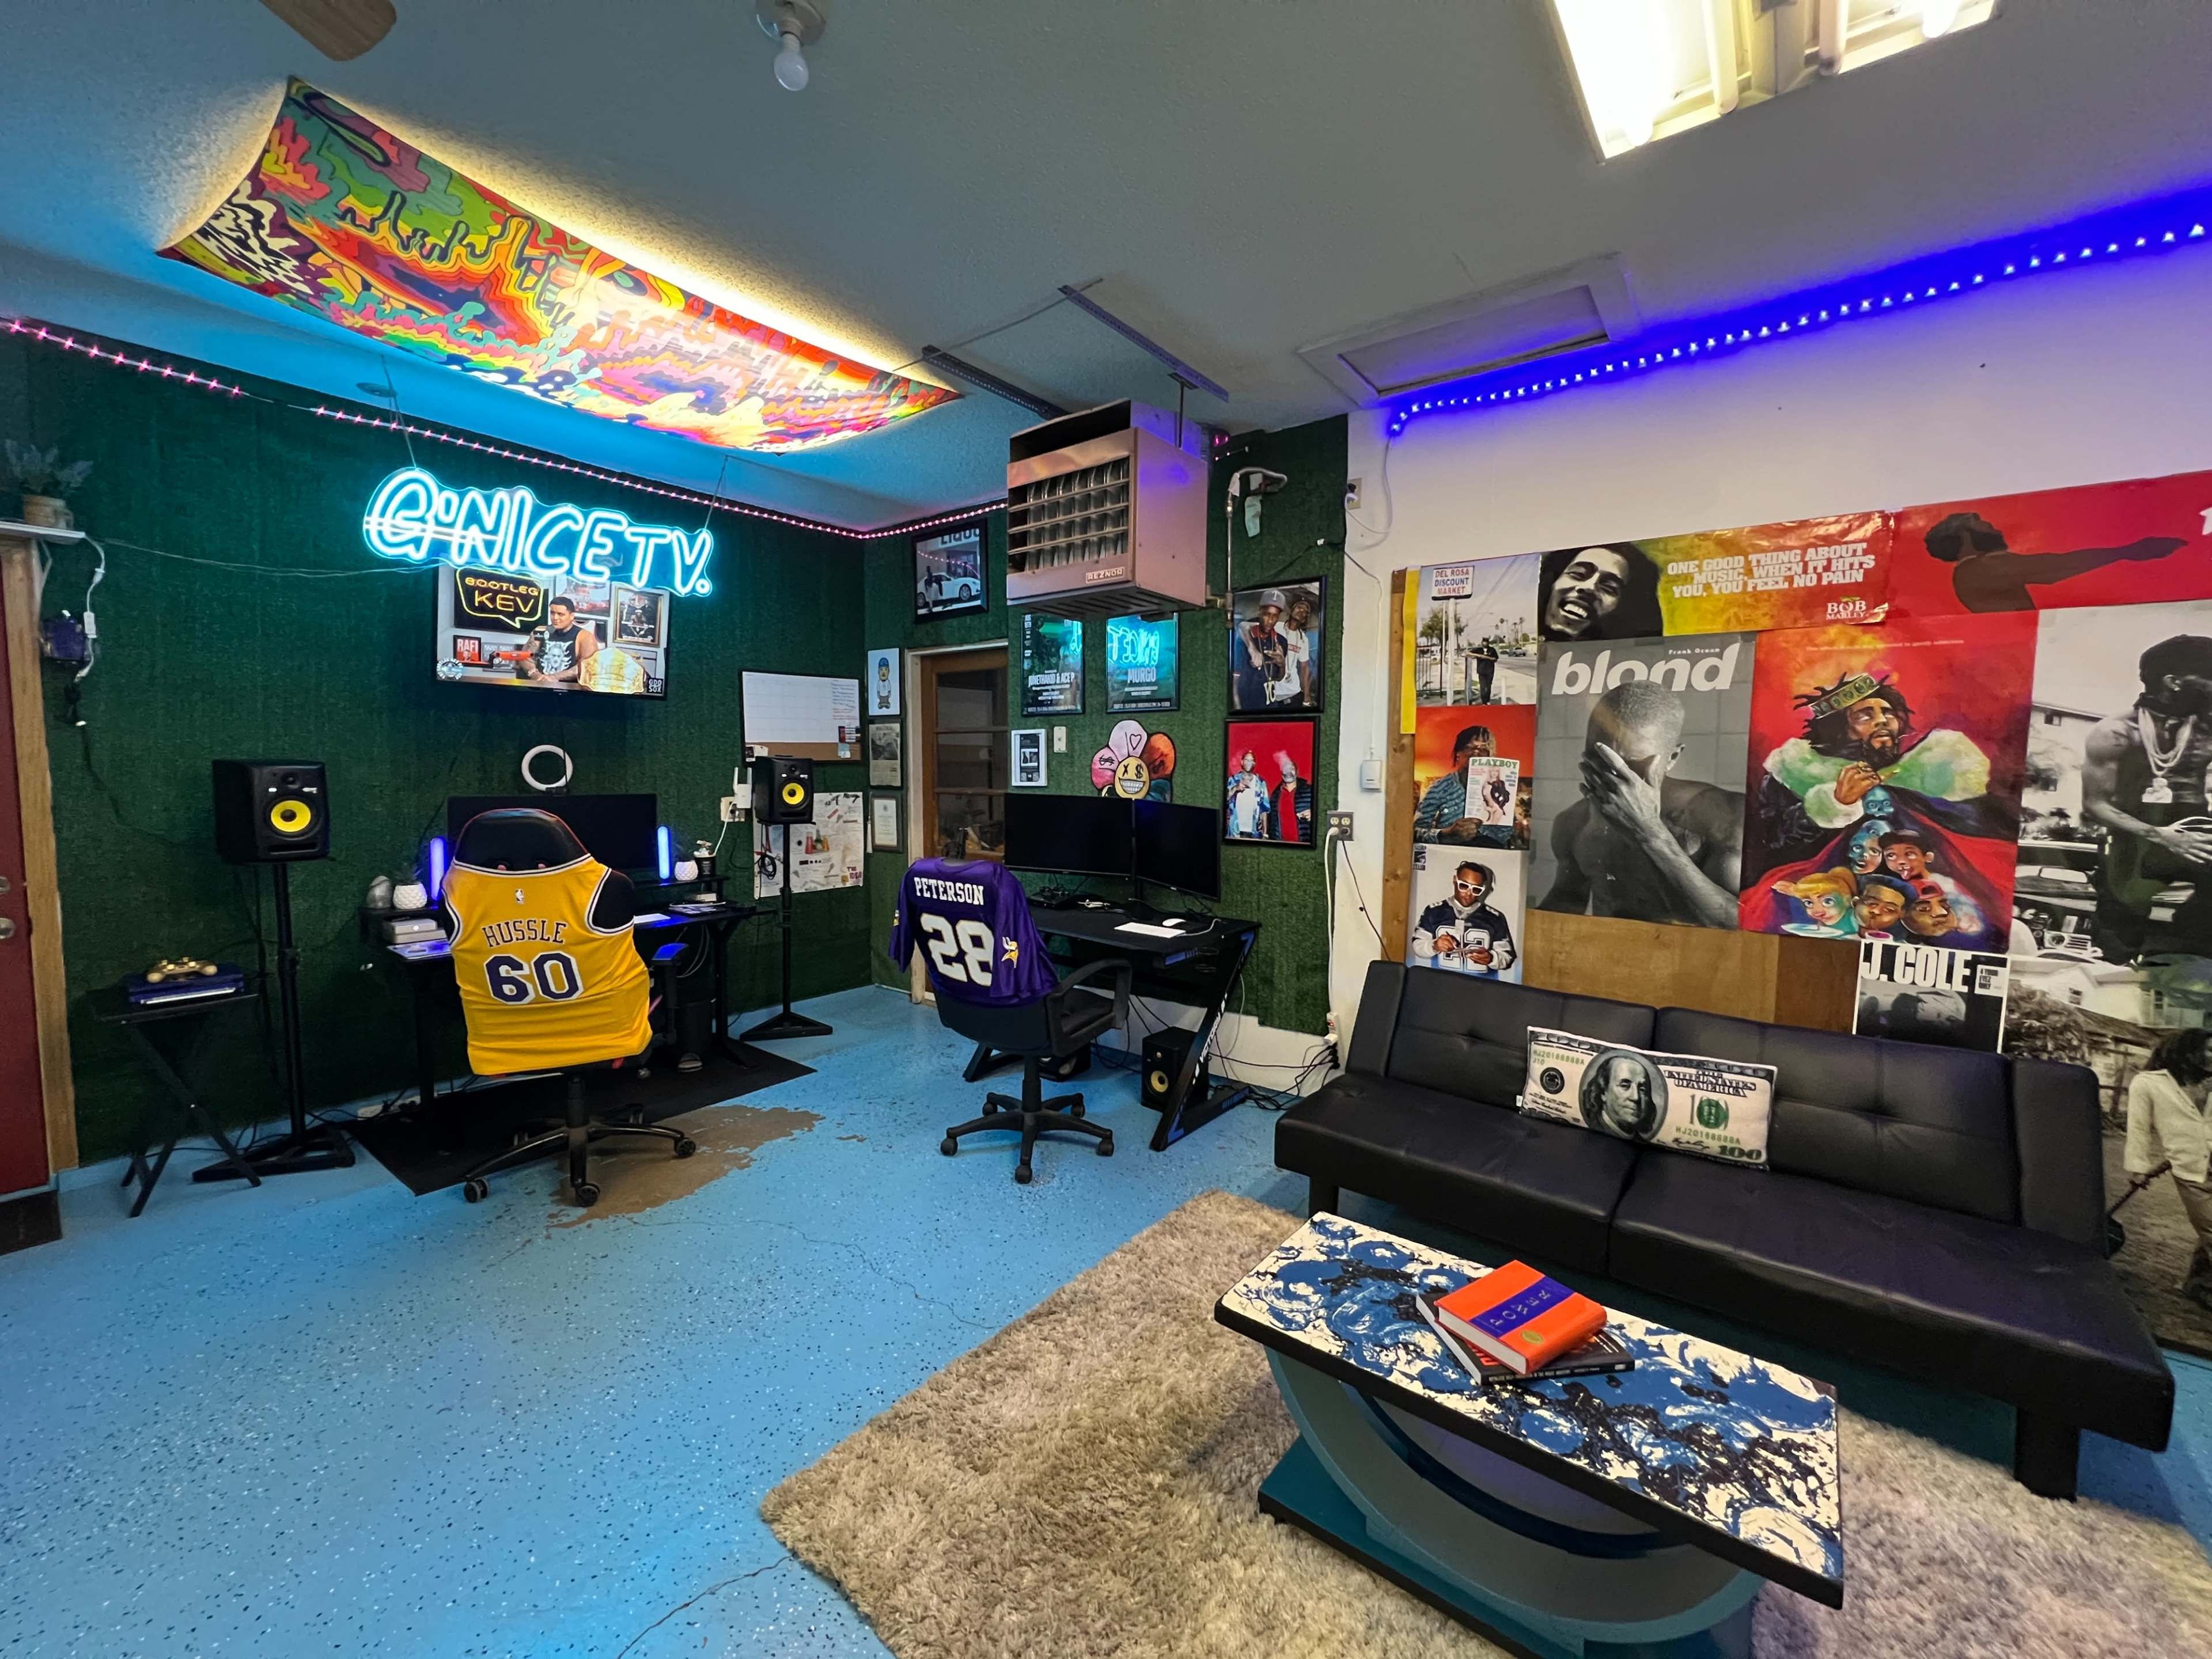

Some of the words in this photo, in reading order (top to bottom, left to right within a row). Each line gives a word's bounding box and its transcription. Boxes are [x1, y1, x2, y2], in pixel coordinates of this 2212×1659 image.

[1667, 560, 1699, 575] ONE
[1702, 556, 1744, 571] GOOD
[1749, 550, 1801, 567] THING
[1805, 543, 1868, 561] ABOUT
[1753, 562, 1802, 578] WHEN
[1808, 560, 1828, 574] IT
[1831, 555, 1875, 571] HITS
[1088, 569, 1123, 580] REZNOR
[1434, 577, 1469, 586] DISCOUNT
[1673, 584, 1707, 597] YOU,
[1711, 581, 1743, 595] YOU
[1747, 577, 1789, 592] FEEL
[1793, 573, 1817, 588] NO
[1821, 569, 1864, 585] PAIN
[465, 577, 539, 596] BOOTLEG
[1437, 586, 1466, 595] MARKET
[475, 590, 535, 613] KEV
[1827, 600, 1867, 615] BOB
[1825, 612, 1865, 620] MARLEY
[457, 638, 479, 652] RAFI
[1127, 667, 1157, 684] MURGO
[1551, 642, 1741, 695] blond
[1264, 681, 1276, 705] YG
[1471, 759, 1518, 769] PLAYBOY
[914, 877, 984, 906] PETERSON
[482, 919, 567, 948] HUSSLE
[921, 912, 995, 987] 28
[483, 950, 584, 1005] 60
[1861, 941, 1888, 982] J.
[1893, 945, 1972, 993] COLE
[1718, 1145, 1763, 1161] 100
[1490, 1289, 1552, 1326] POWER
